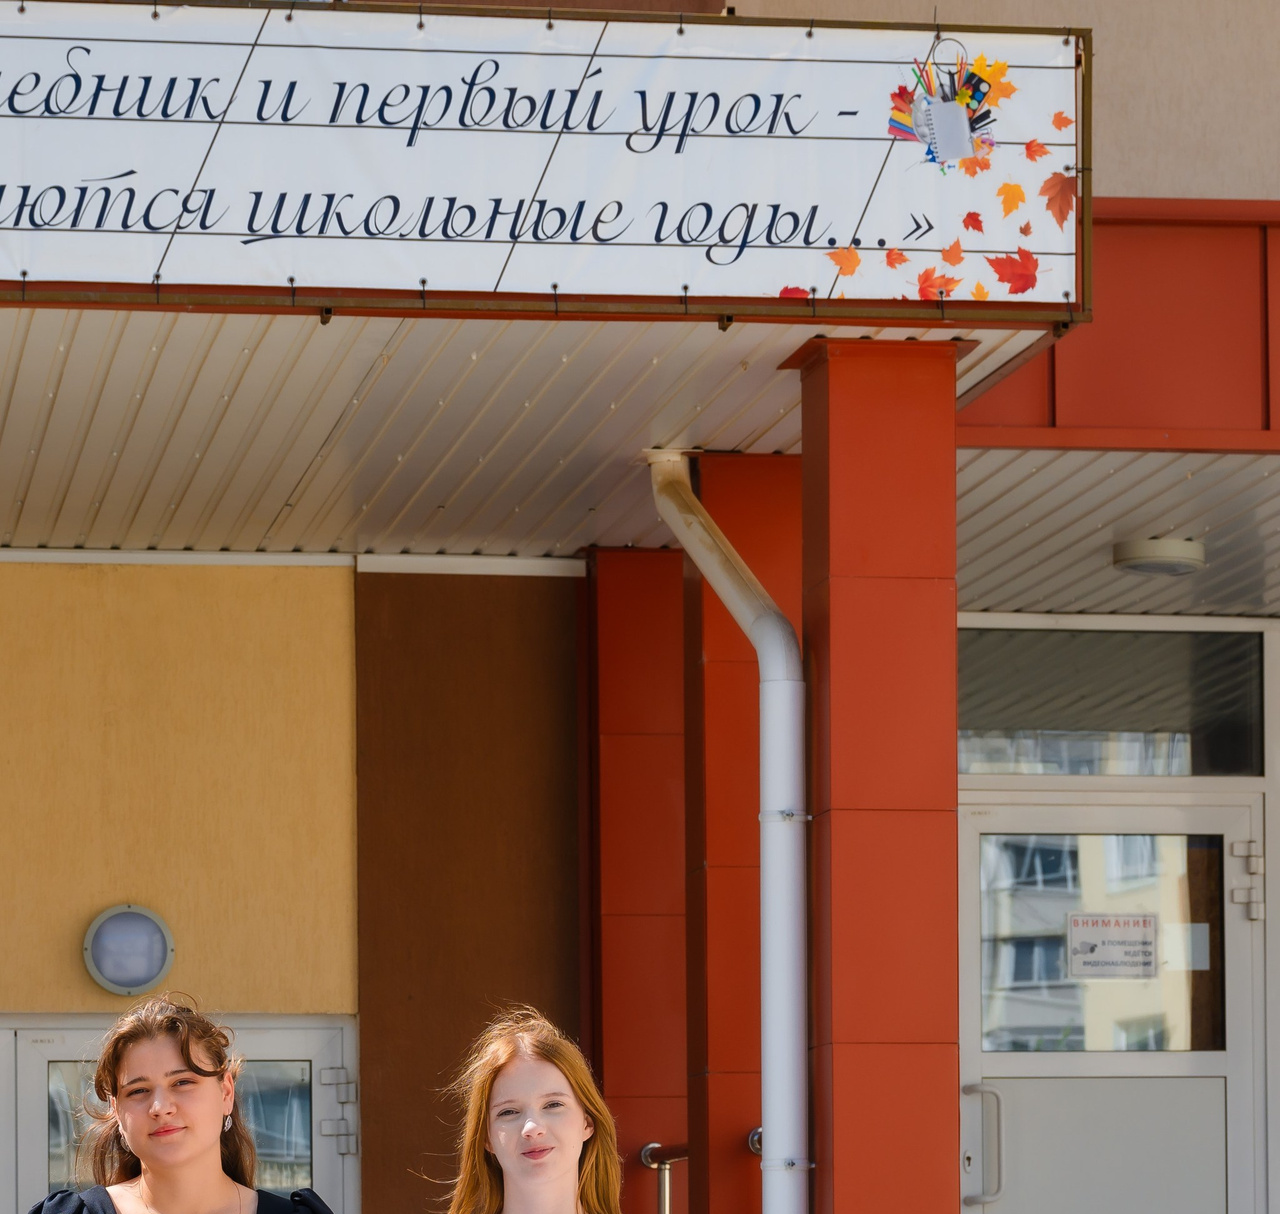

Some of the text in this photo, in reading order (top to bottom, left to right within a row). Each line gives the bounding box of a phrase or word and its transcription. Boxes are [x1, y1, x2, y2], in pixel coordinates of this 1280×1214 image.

[255, 78, 319, 124] и
[327, 58, 616, 148] первый
[625, 82, 820, 154] урок
[240, 188, 638, 246] школьные
[1073, 919, 1152, 928] ВНИМАНИЕ!
